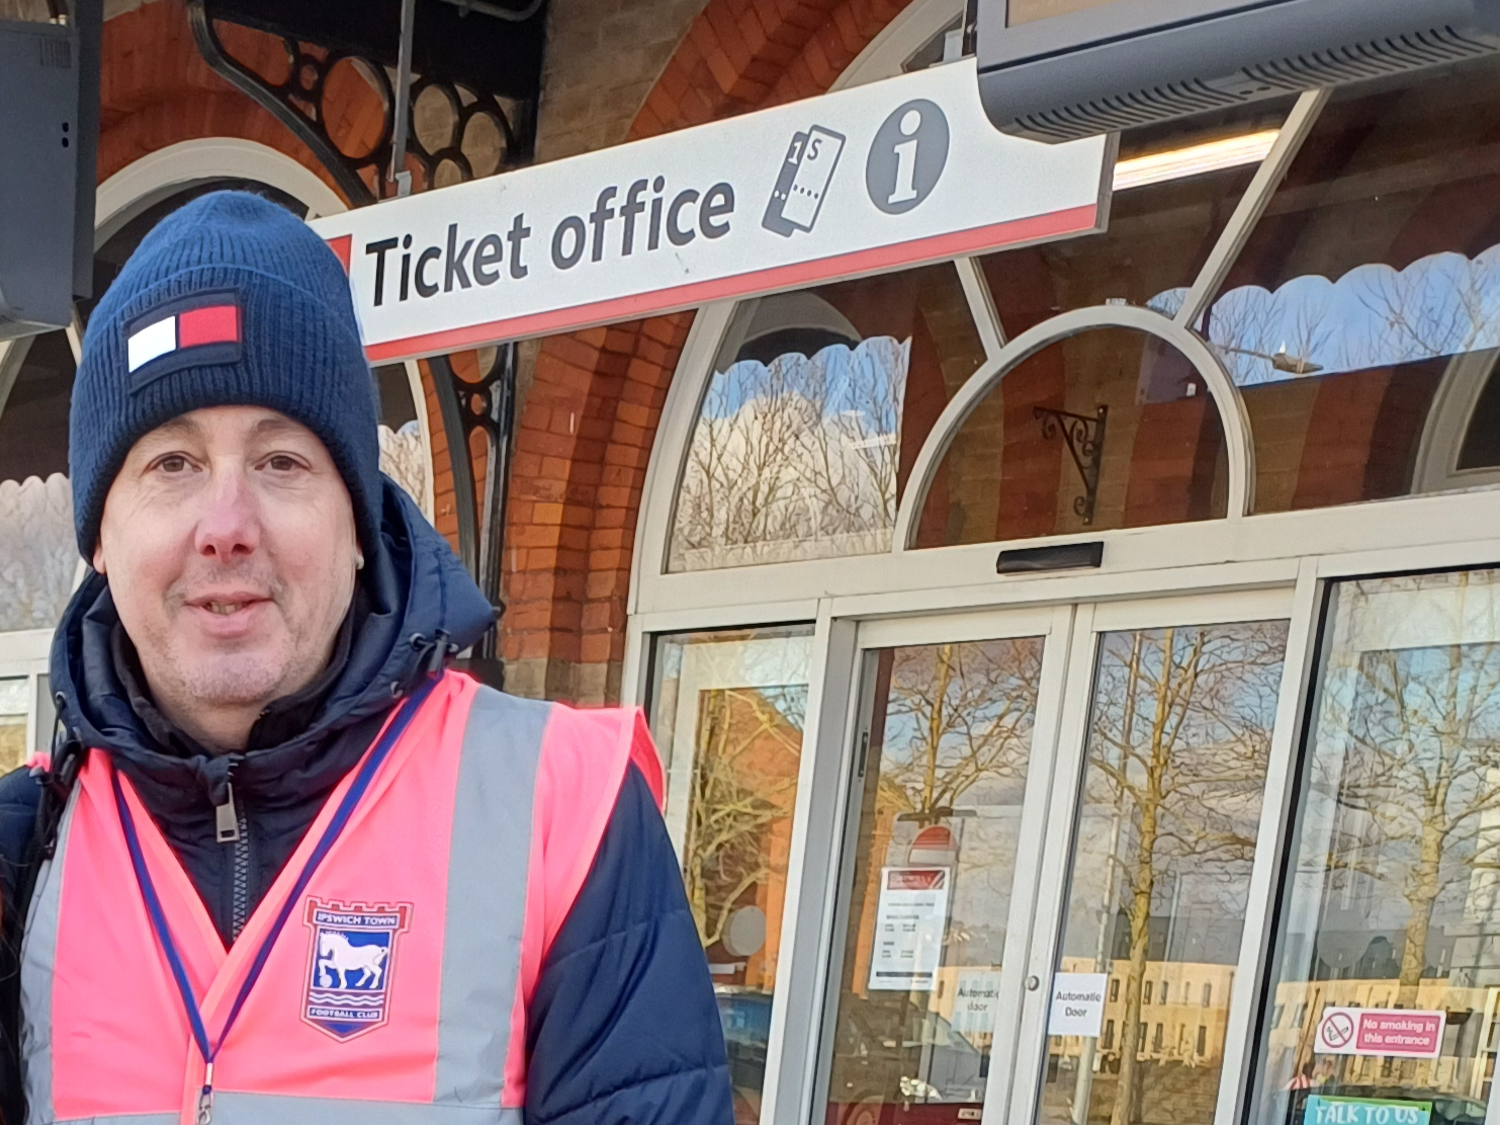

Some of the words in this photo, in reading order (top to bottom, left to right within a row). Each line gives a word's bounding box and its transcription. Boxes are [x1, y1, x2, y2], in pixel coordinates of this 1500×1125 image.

[365, 212, 532, 307] Ticket
[550, 174, 736, 271] office
[317, 912, 363, 925] IPSWICH
[363, 915, 396, 926] TOWN
[1056, 991, 1102, 1003] Automatic
[310, 1007, 354, 1019] FOOTBALL
[355, 1009, 379, 1020] CLUB
[1065, 1006, 1088, 1018] Door
[1362, 1019, 1377, 1030] No
[1379, 1020, 1424, 1033] smoking
[1425, 1021, 1436, 1032] in
[1363, 1032, 1383, 1043] this
[1384, 1034, 1430, 1046] entrance
[1314, 1106, 1360, 1125] TALK
[1364, 1106, 1390, 1125] TO
[1394, 1107, 1420, 1125] US
